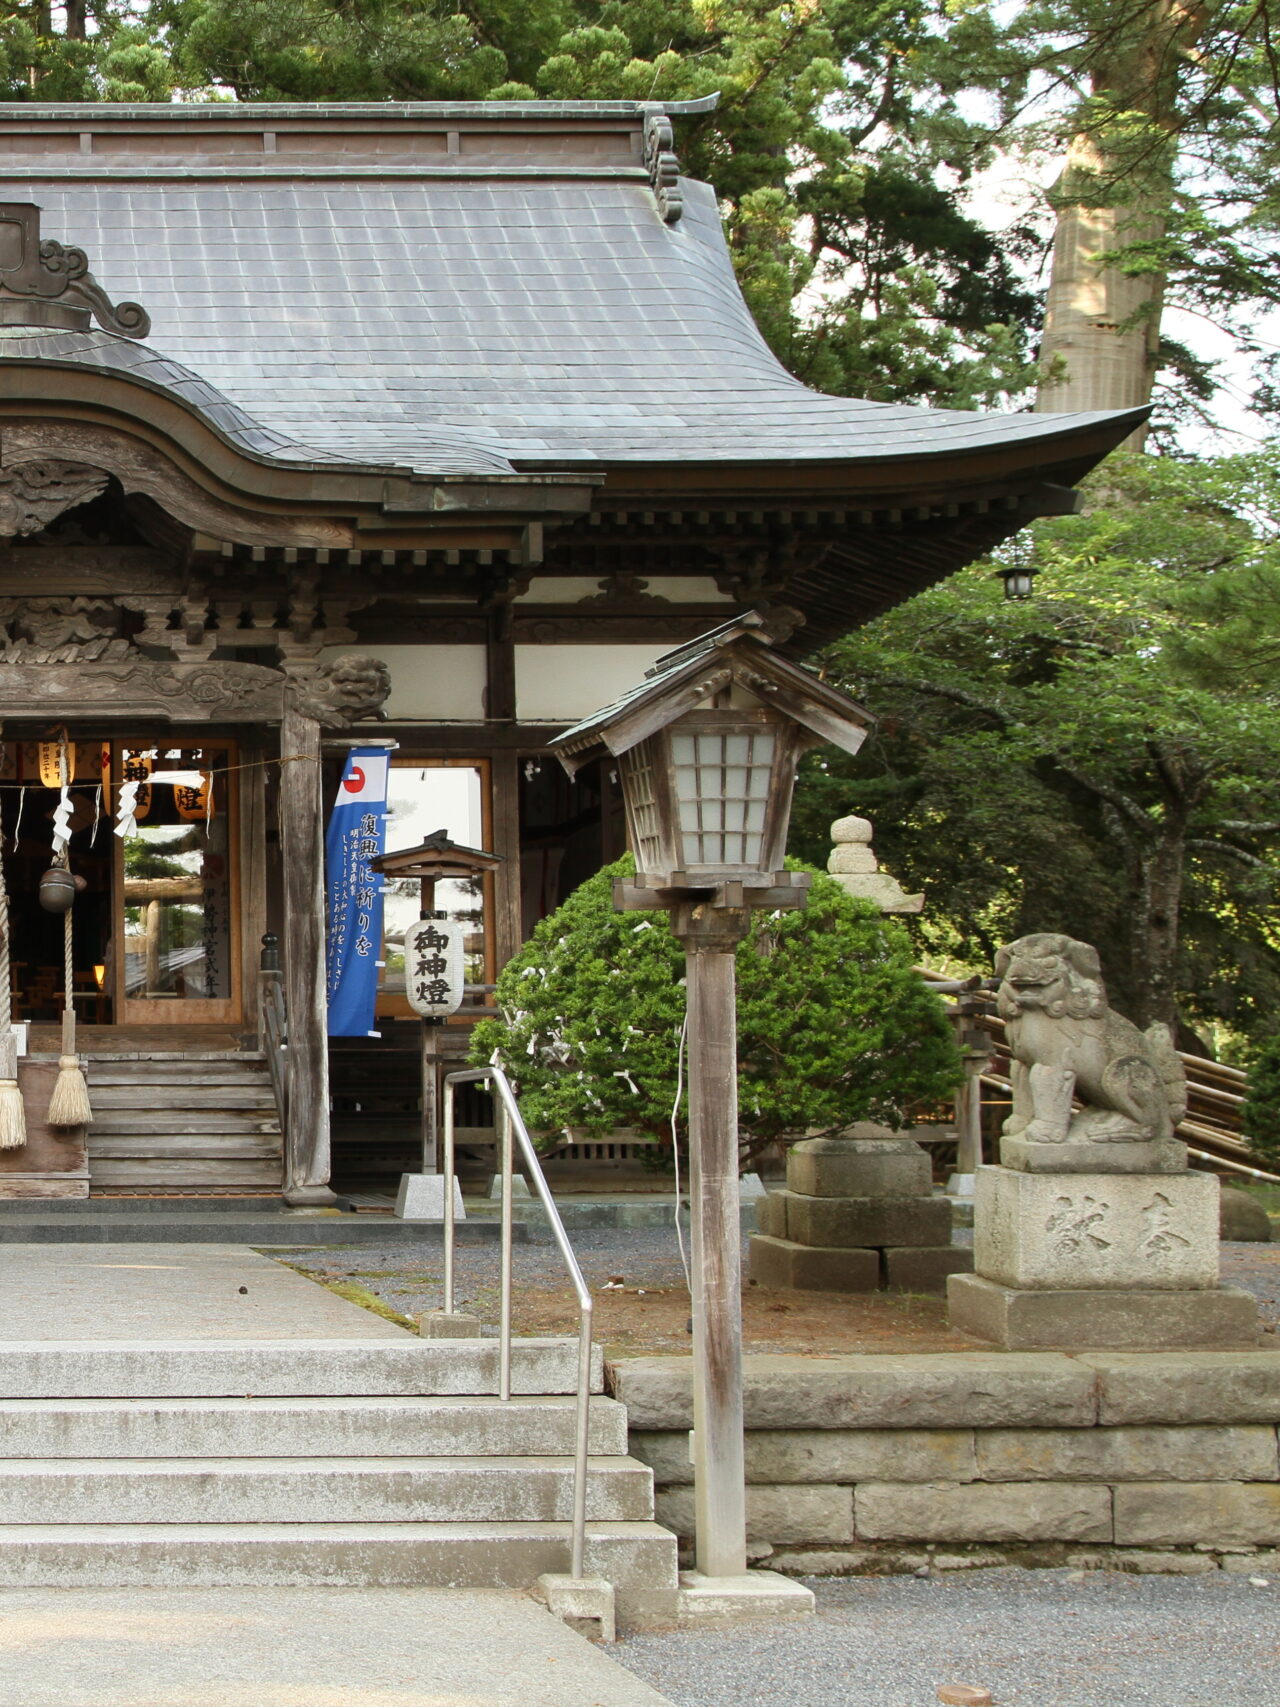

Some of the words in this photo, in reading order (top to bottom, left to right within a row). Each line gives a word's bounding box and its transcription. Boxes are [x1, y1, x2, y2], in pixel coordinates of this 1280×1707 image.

[355, 813, 381, 957] 復興に祈りを
[413, 925, 451, 1005] 御神燈
